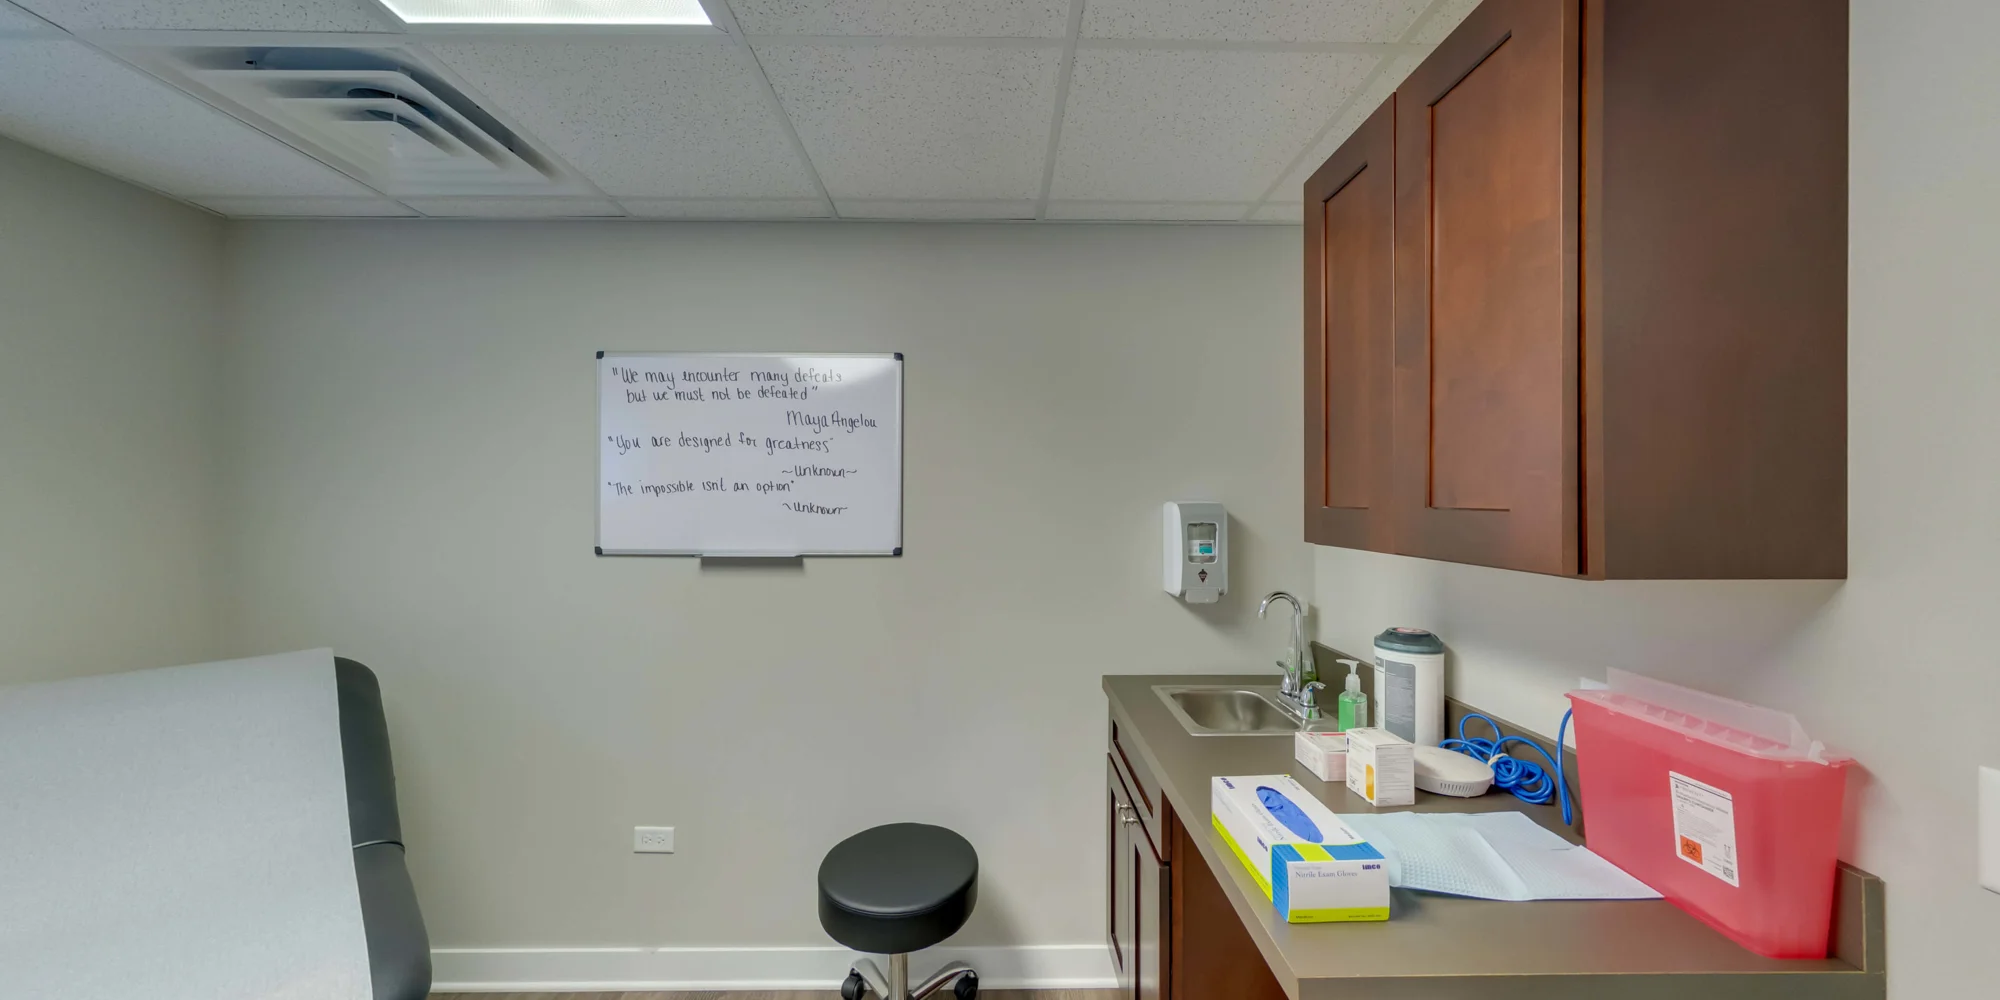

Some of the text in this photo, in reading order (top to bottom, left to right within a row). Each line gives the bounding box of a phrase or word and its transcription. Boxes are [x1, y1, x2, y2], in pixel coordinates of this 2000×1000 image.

[612, 367, 842, 390] "We may encounter many defeats
[626, 389, 647, 403] but
[652, 390, 670, 401] we
[675, 389, 705, 402] must
[712, 388, 730, 400] not
[737, 388, 750, 400] be
[786, 410, 878, 434] Maya Angelou
[608, 432, 641, 455] "You
[652, 436, 672, 447] are
[678, 432, 732, 454] designed
[739, 433, 756, 448] for
[640, 480, 694, 497] impossible
[734, 482, 749, 492] an
